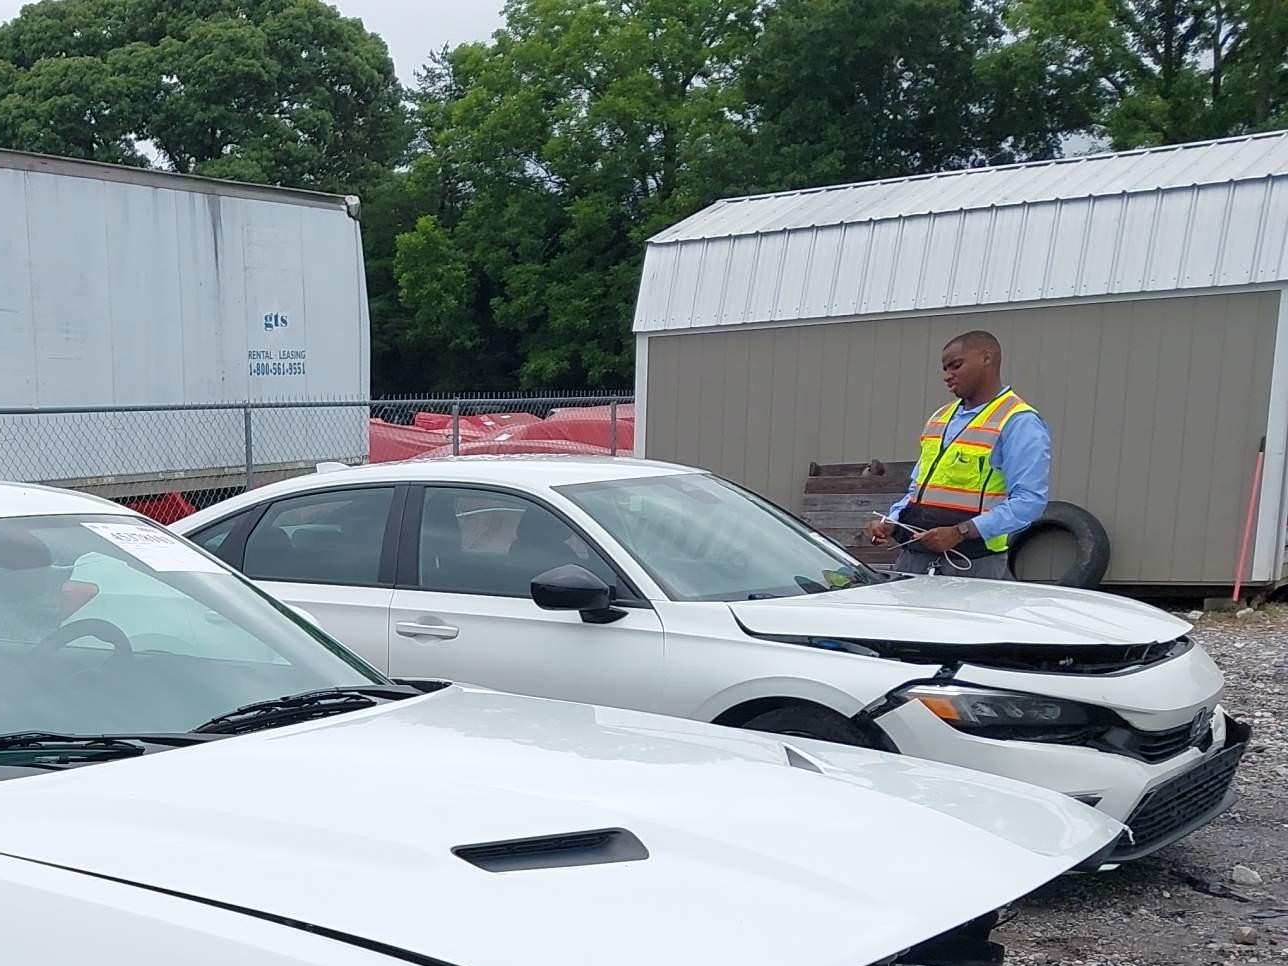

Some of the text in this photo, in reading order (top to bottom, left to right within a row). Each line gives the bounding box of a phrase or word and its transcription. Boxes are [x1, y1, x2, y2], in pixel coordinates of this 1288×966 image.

[263, 312, 288, 331] gts
[247, 350, 306, 360] RENTAL LEASING
